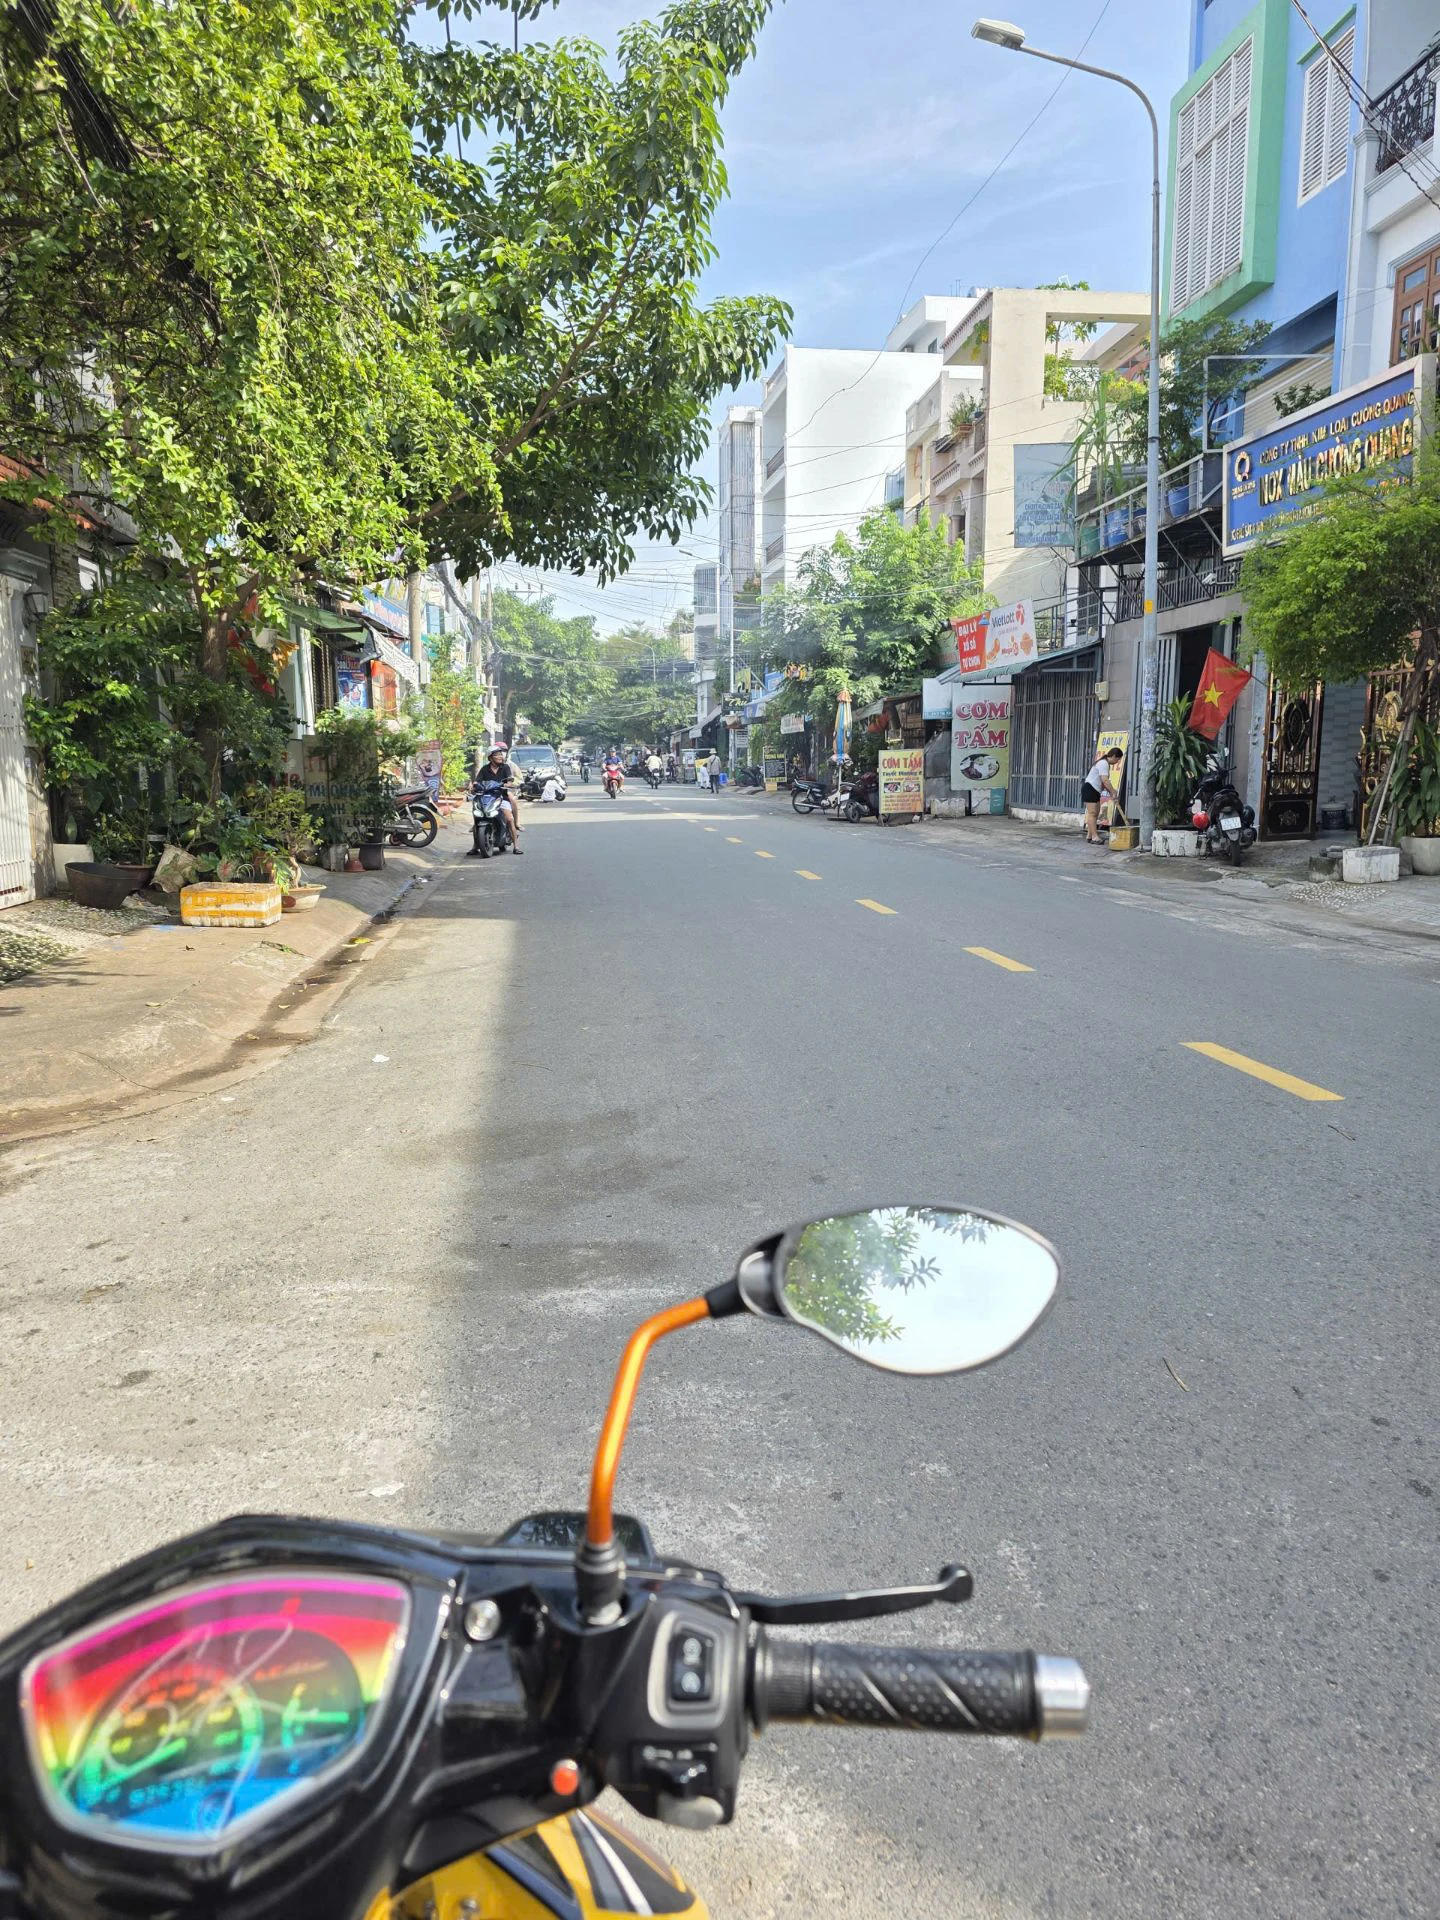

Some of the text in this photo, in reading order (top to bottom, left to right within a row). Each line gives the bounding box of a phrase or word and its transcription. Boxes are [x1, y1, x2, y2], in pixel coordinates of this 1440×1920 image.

[1280, 442, 1290, 455] TY
[1383, 389, 1415, 415] QUANG
[956, 700, 1009, 720] CƠM
[955, 723, 1009, 748] TẤM
[882, 752, 922, 769] CƠM TẤM
